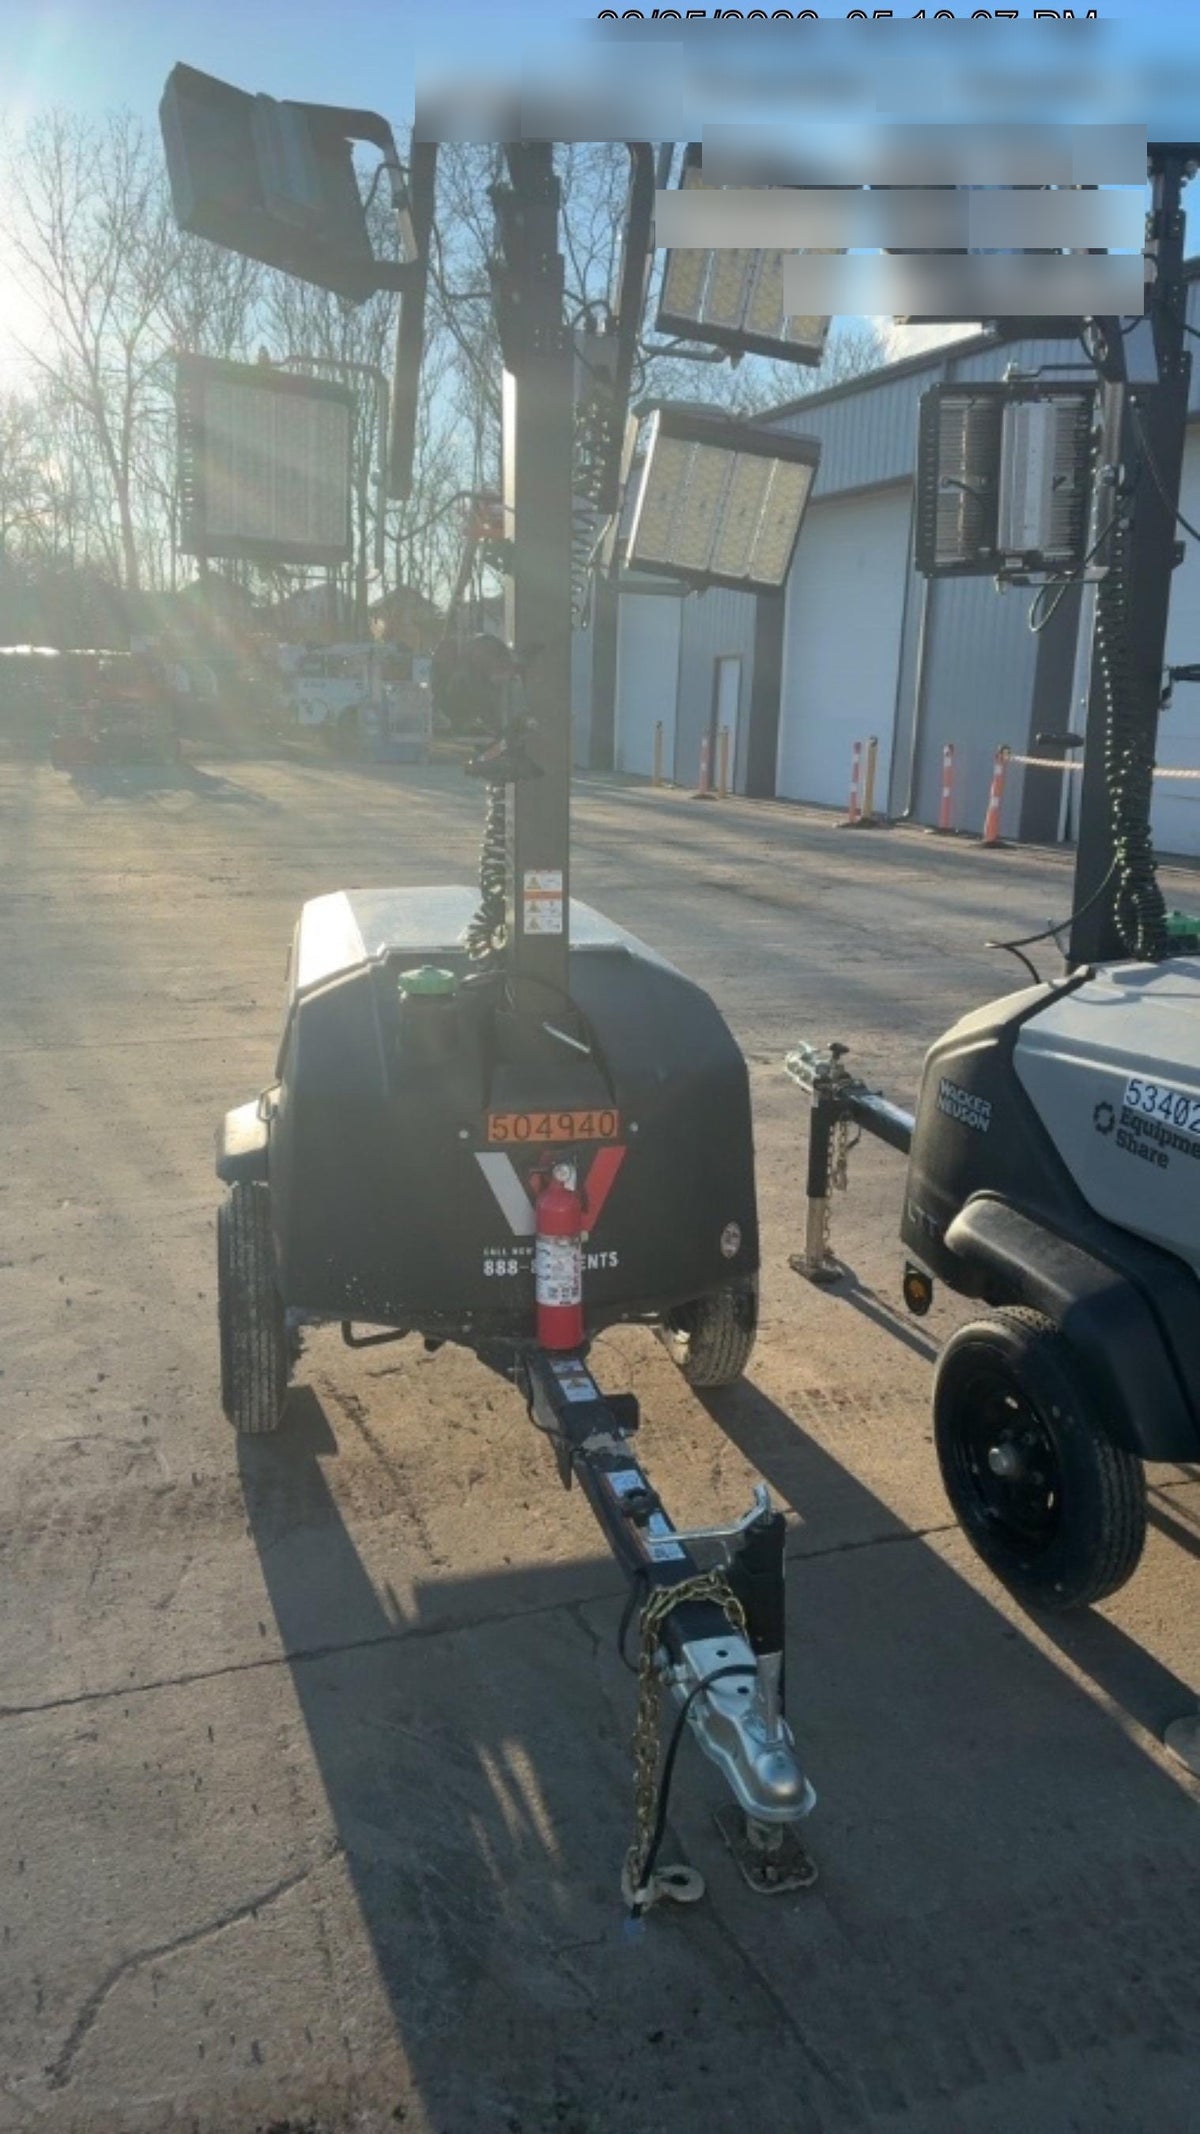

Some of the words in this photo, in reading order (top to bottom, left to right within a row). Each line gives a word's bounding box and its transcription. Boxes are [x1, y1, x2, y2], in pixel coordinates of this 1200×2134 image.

[940, 1078, 992, 1118] WACKER
[1126, 1078, 1200, 1134] 53402
[492, 1110, 616, 1140] 504940
[1116, 1127, 1170, 1169] Share
